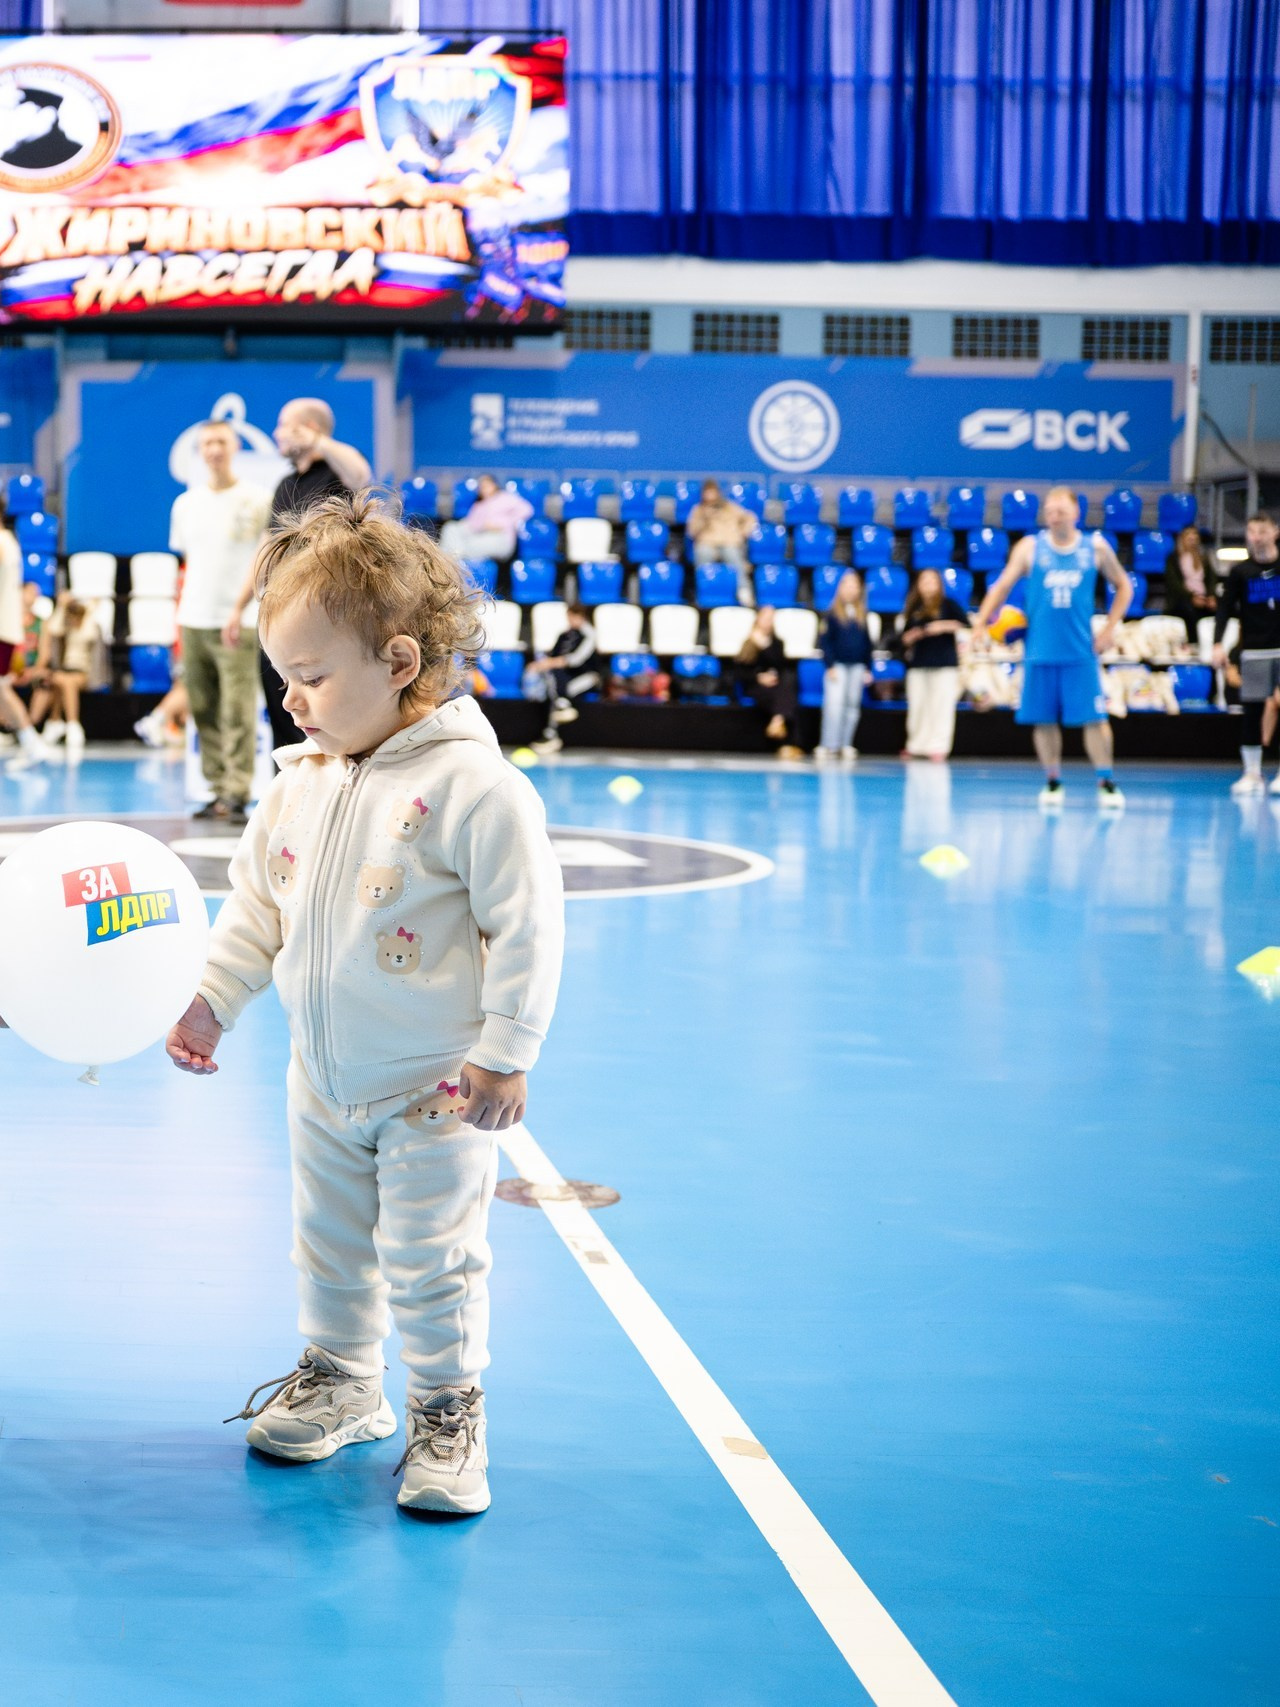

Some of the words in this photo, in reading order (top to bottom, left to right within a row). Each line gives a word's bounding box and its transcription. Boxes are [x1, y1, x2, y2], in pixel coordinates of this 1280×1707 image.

[0, 201, 471, 266] ЖИРИНОВСКИЙ
[73, 248, 377, 315] НАВСЕГДА
[79, 866, 119, 901] ЗА
[96, 892, 171, 936] ЛДПР
